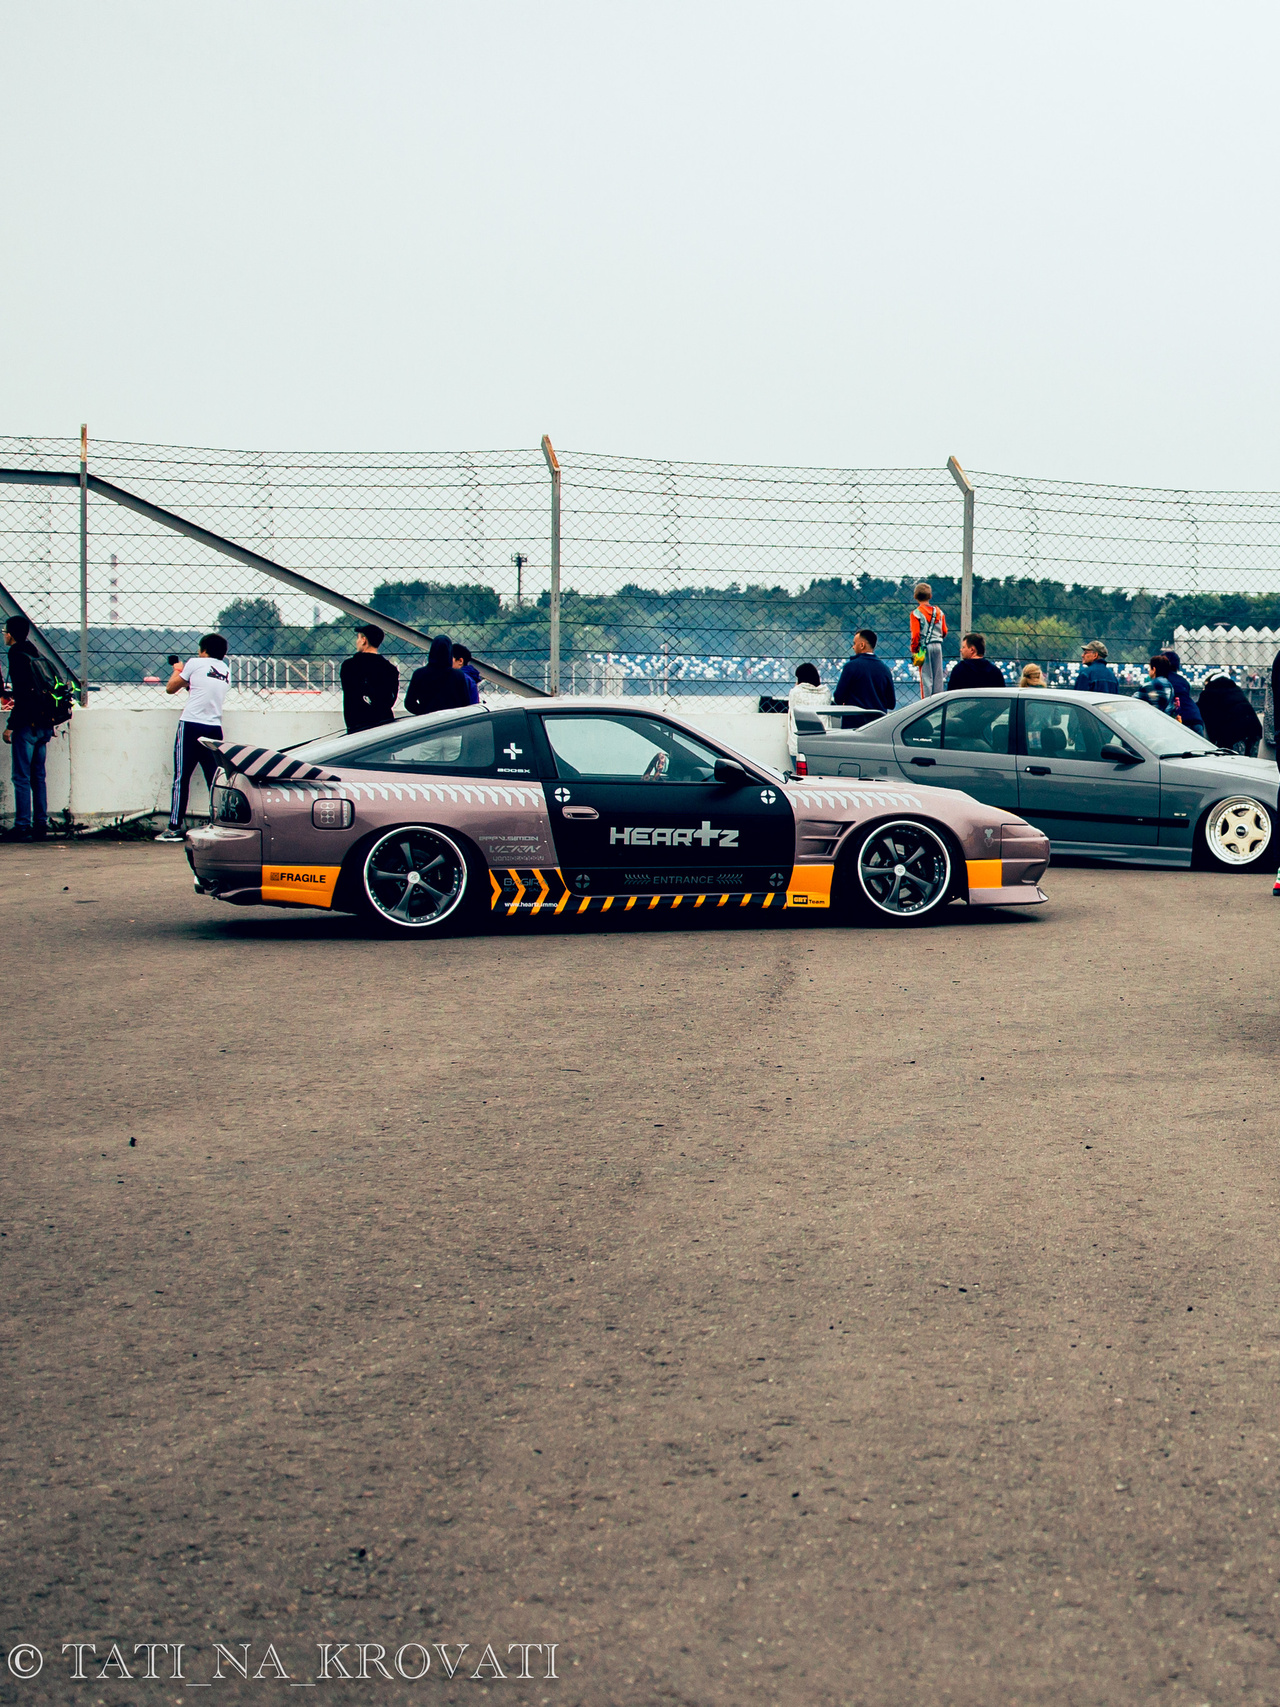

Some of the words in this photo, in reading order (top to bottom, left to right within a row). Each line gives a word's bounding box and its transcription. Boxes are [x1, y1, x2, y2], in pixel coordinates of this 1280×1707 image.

[609, 820, 740, 848] HEARTZ
[280, 872, 326, 884] FRAGILE
[652, 875, 714, 884] ENTRANCE
